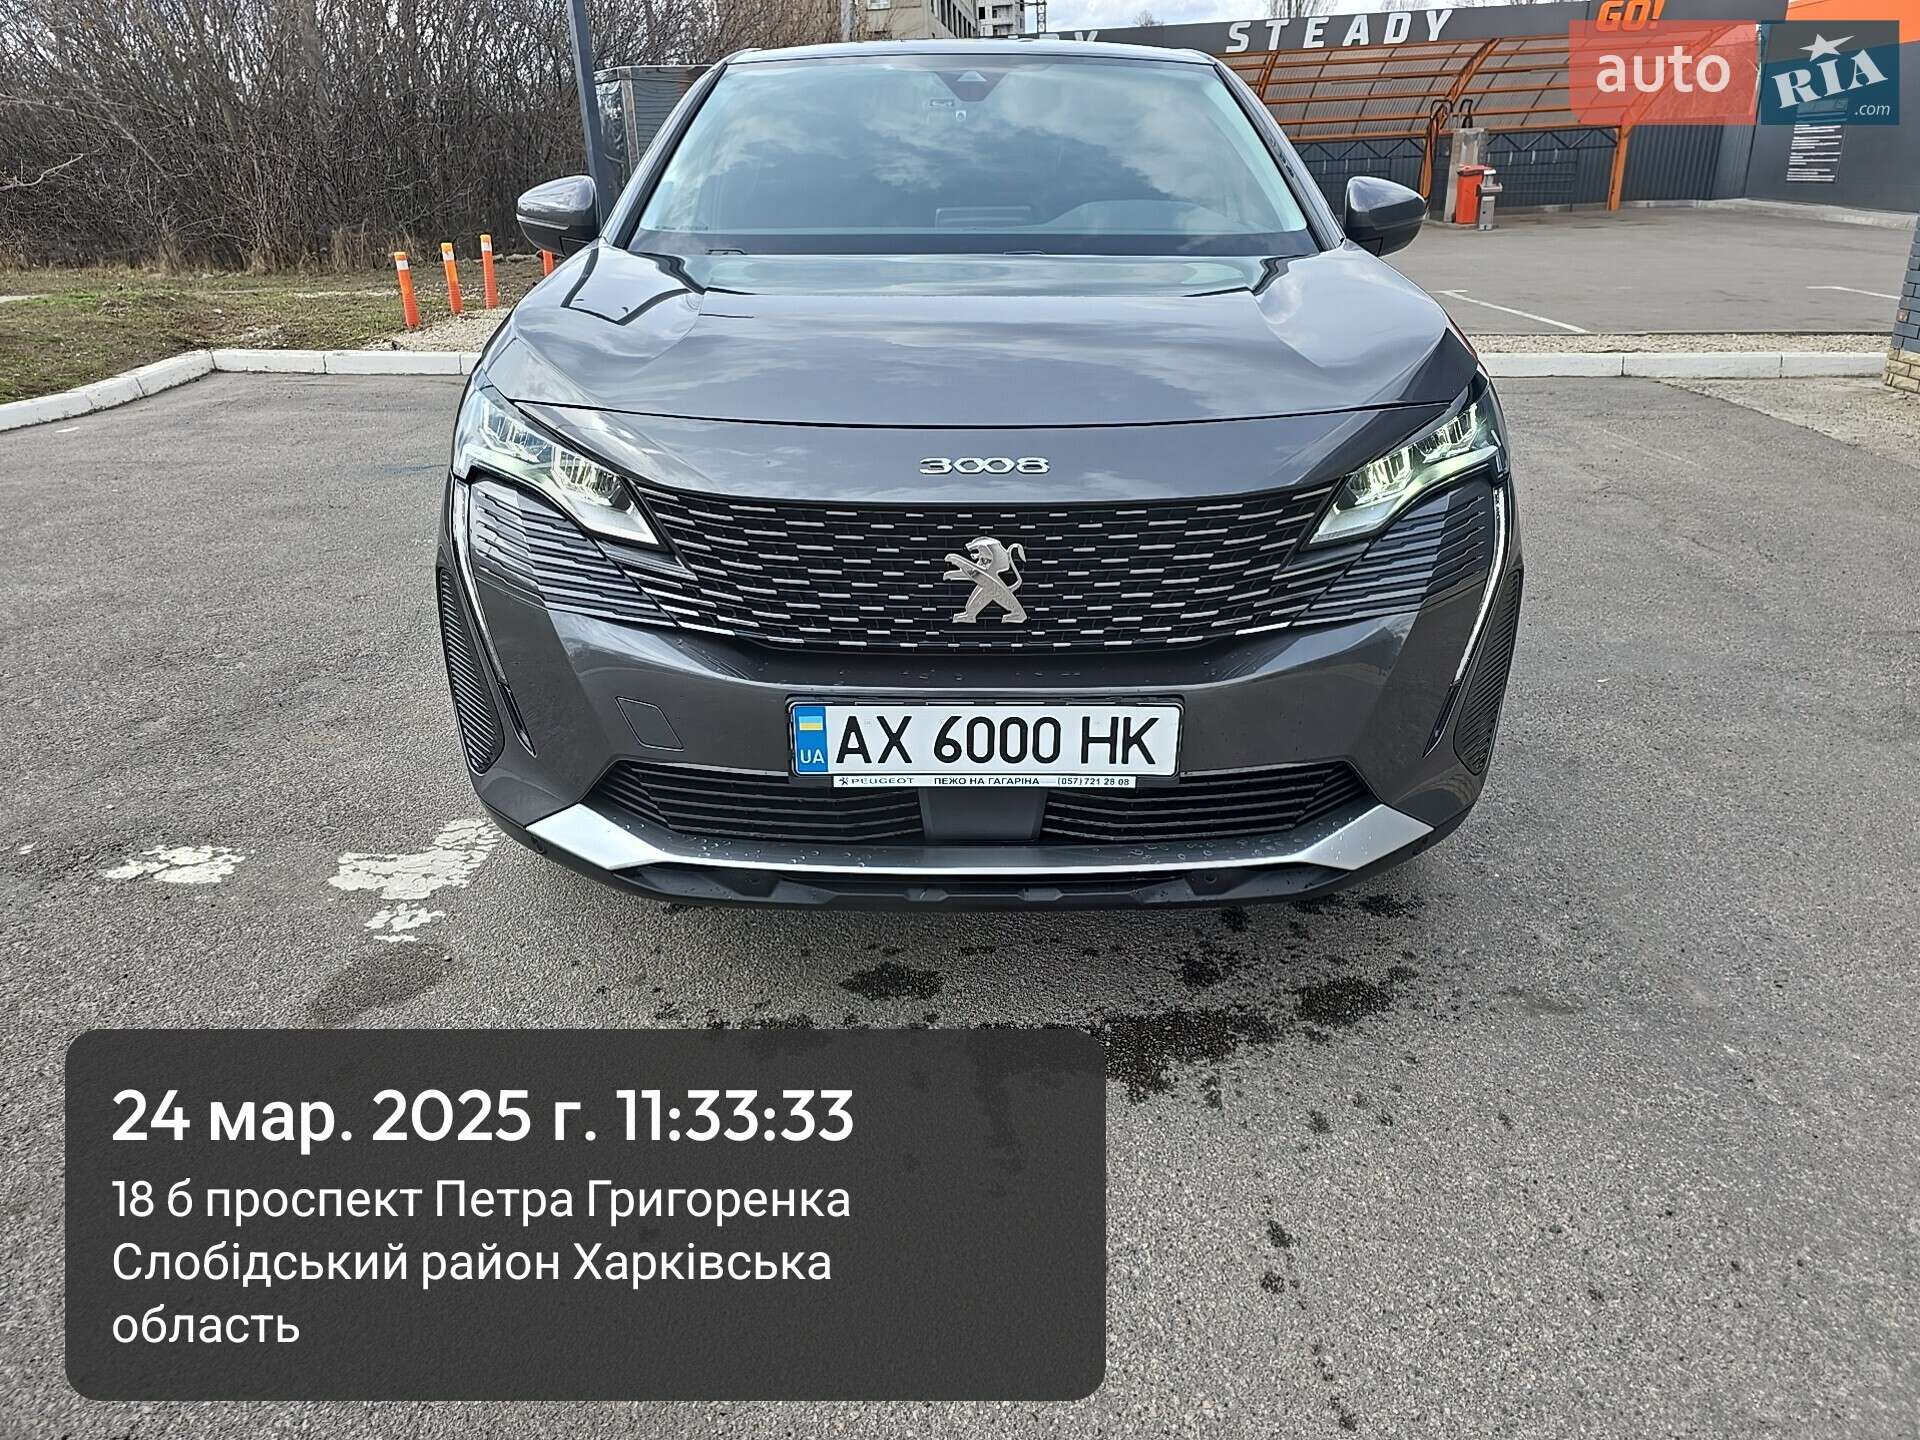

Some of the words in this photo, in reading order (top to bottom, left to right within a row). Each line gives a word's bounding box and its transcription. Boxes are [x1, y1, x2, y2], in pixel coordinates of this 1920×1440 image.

[1596, 0, 1665, 32] GO!
[1225, 9, 1453, 53] STEADY
[919, 457, 1050, 475] 3008
[835, 715, 913, 764] AX
[933, 716, 1062, 764] 6000
[1080, 716, 1160, 765] HK
[800, 748, 825, 765] UA
[851, 777, 915, 785] PEUGEOT
[934, 777, 966, 786] ПЕЖО
[969, 777, 985, 786] НА
[988, 777, 1040, 786] ГАГАРІНА
[1103, 777, 1115, 786] 28
[1117, 777, 1130, 786] 08
